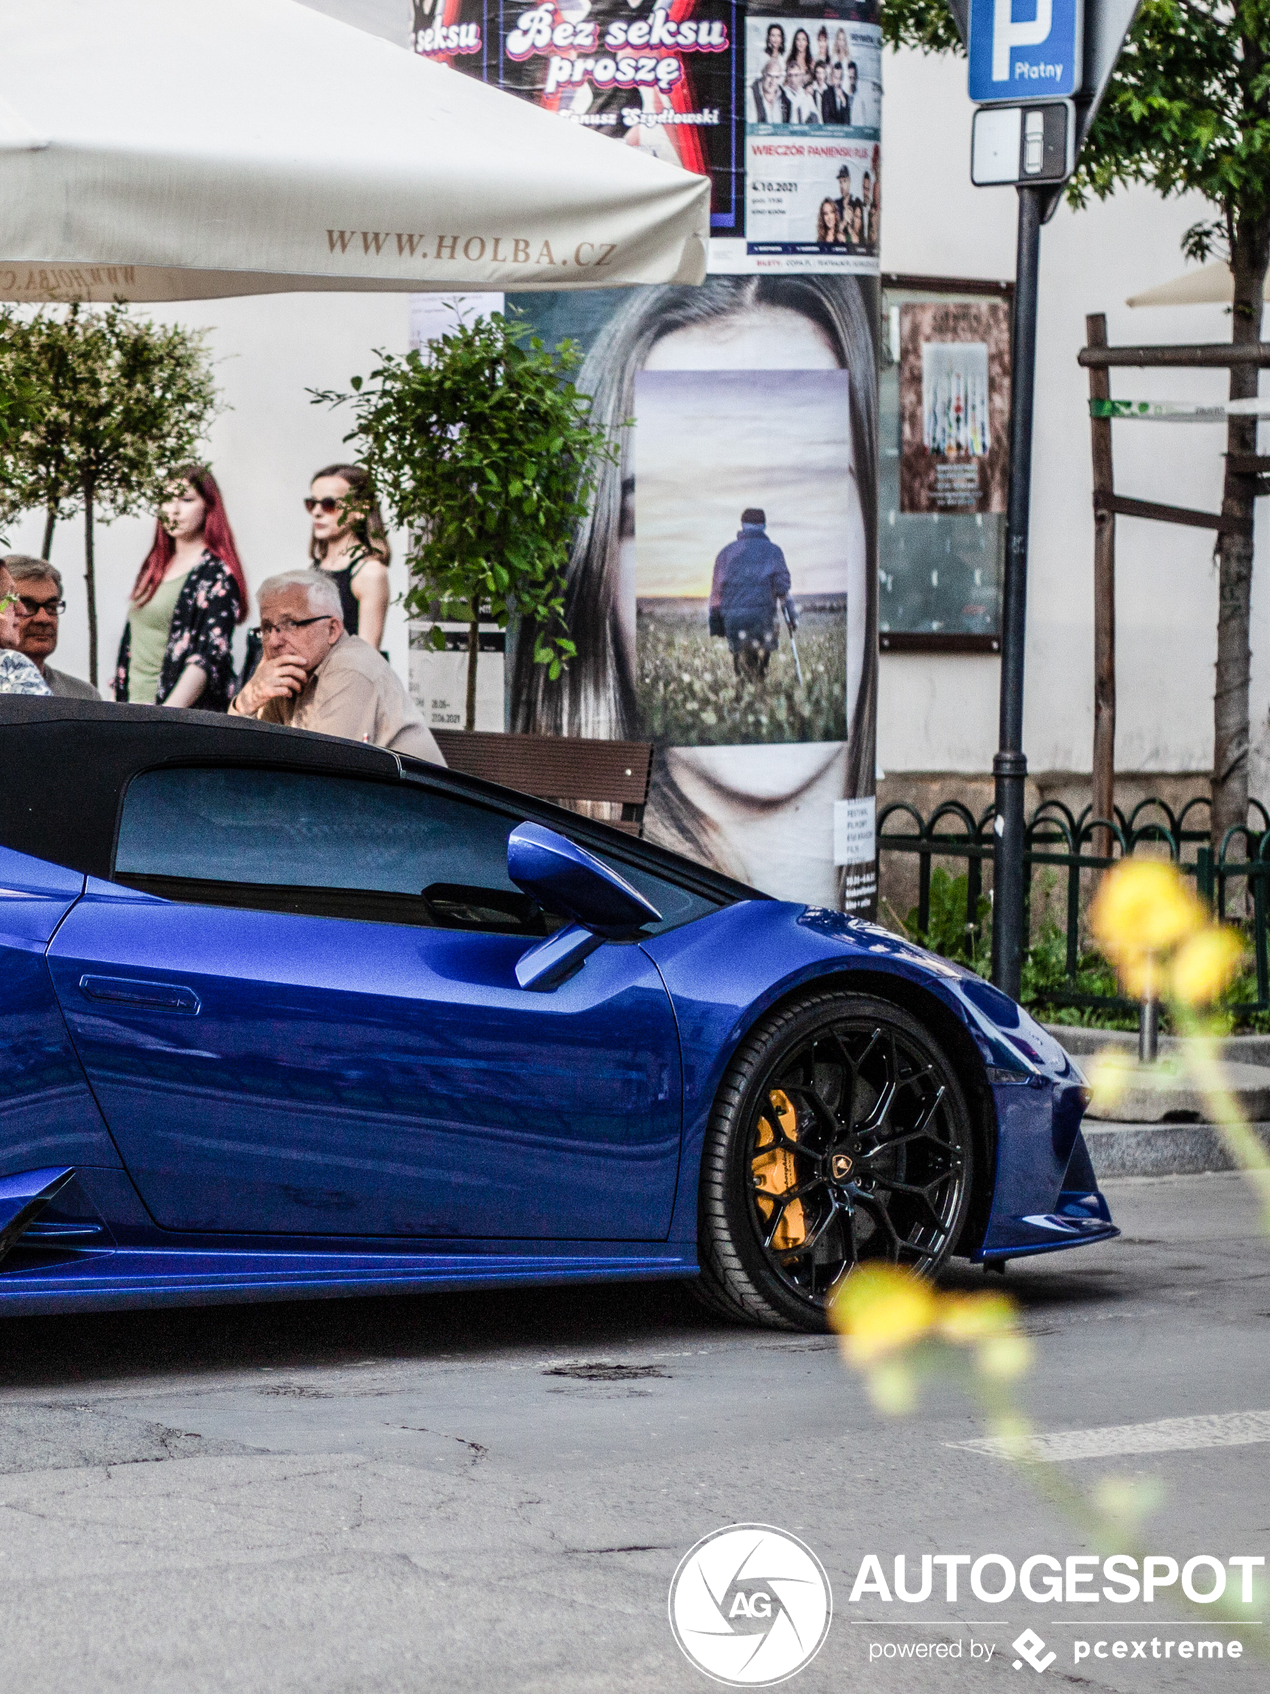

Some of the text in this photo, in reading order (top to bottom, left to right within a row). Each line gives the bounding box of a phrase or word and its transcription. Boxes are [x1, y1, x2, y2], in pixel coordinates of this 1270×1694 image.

[416, 17, 481, 54] seksu
[506, 3, 729, 61] Bez seksu
[544, 56, 683, 98] proszę
[1014, 61, 1063, 82] Płatny
[621, 107, 720, 128] Szydłowski
[751, 142, 805, 157] WIECZÓR
[326, 229, 618, 267] WWW.HOLBA.CZ
